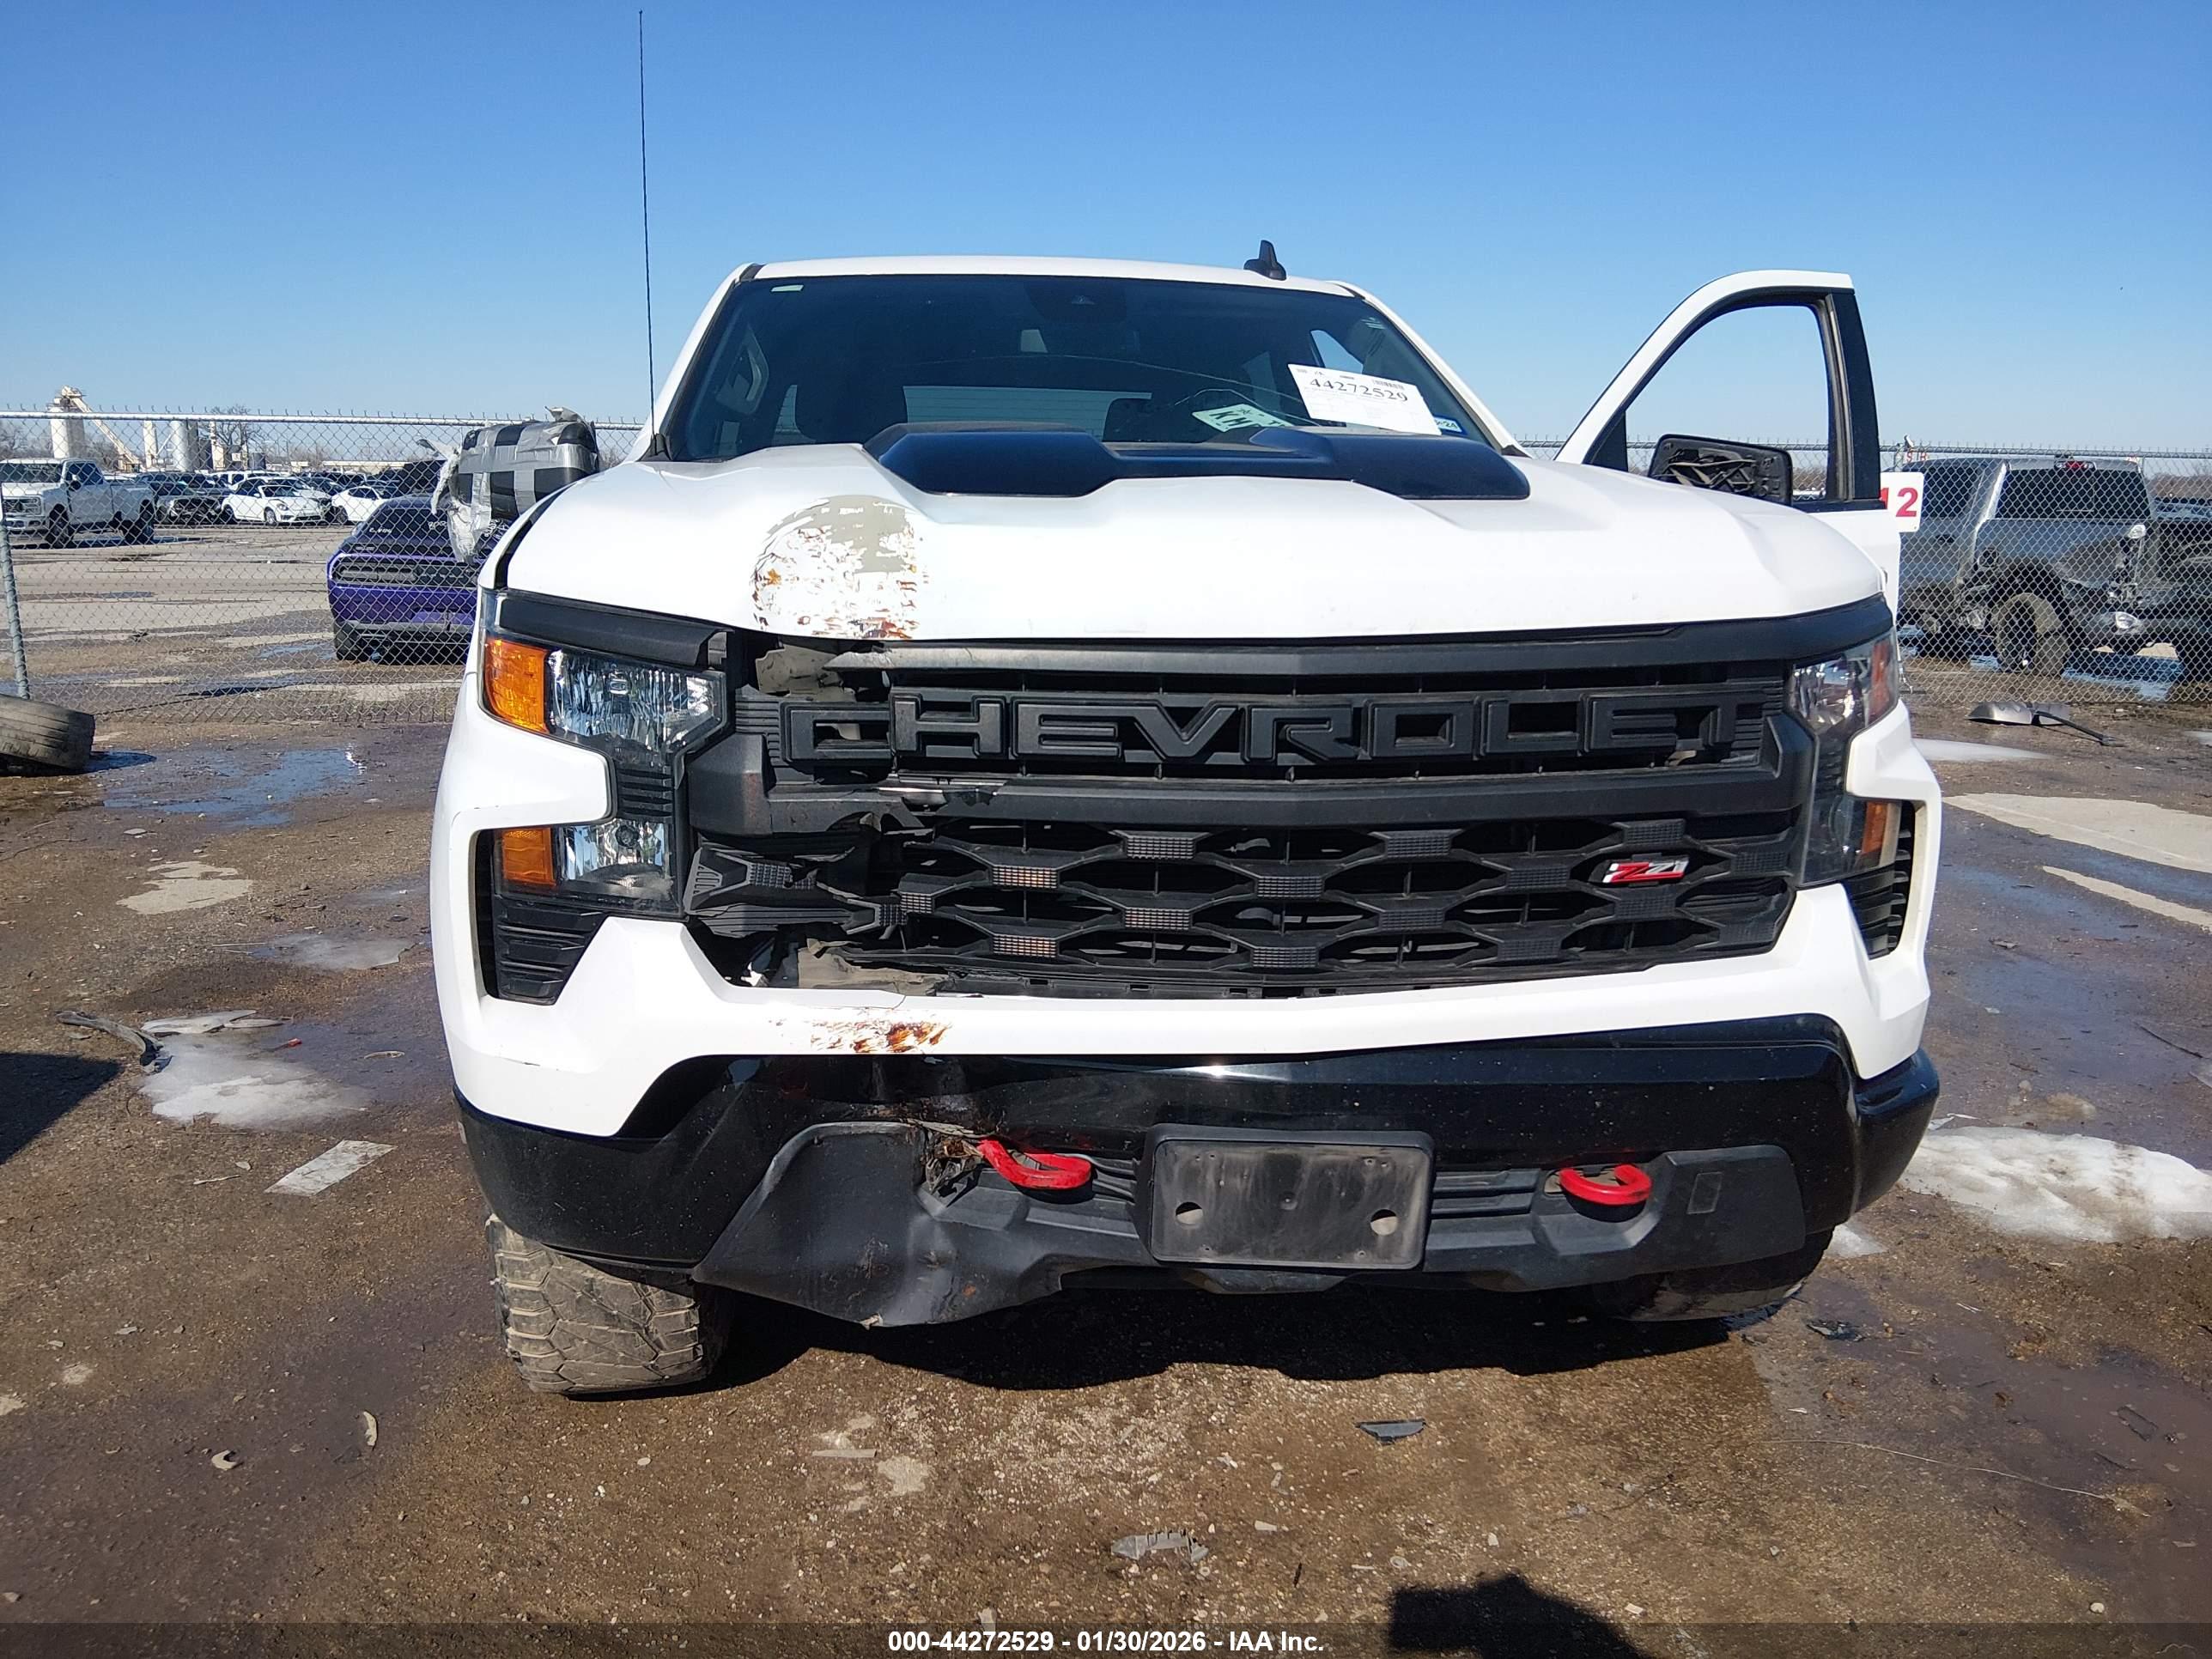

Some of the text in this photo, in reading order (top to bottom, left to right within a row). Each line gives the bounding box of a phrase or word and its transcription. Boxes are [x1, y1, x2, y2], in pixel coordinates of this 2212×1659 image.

[1310, 378, 1408, 402] 44272529
[781, 690, 1767, 763] CHEVROLET
[1602, 860, 1689, 885] Z71
